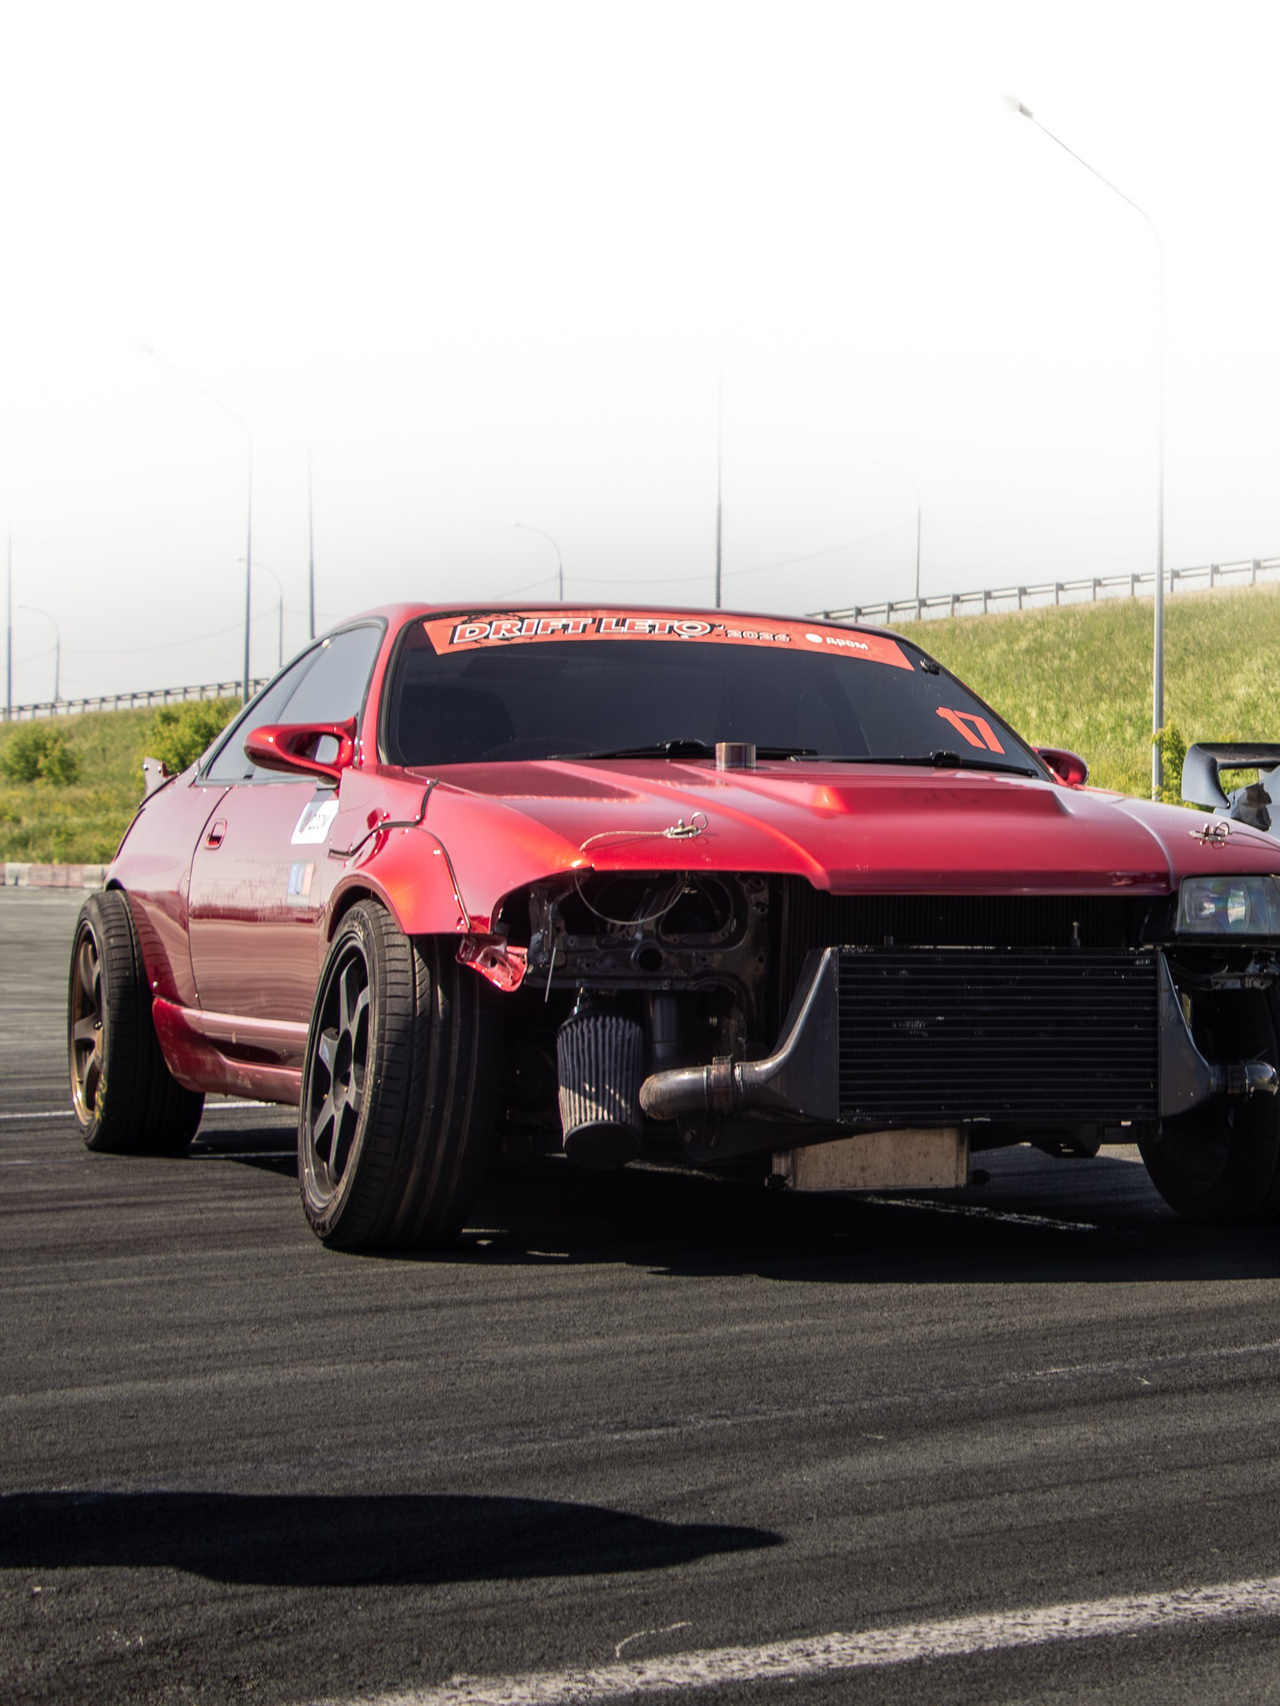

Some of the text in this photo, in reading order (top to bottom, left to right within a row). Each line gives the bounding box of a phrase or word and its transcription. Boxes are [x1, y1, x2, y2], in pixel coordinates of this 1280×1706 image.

[451, 616, 594, 644] DRIFT
[599, 616, 713, 638] LETO
[936, 707, 1005, 754] 17
